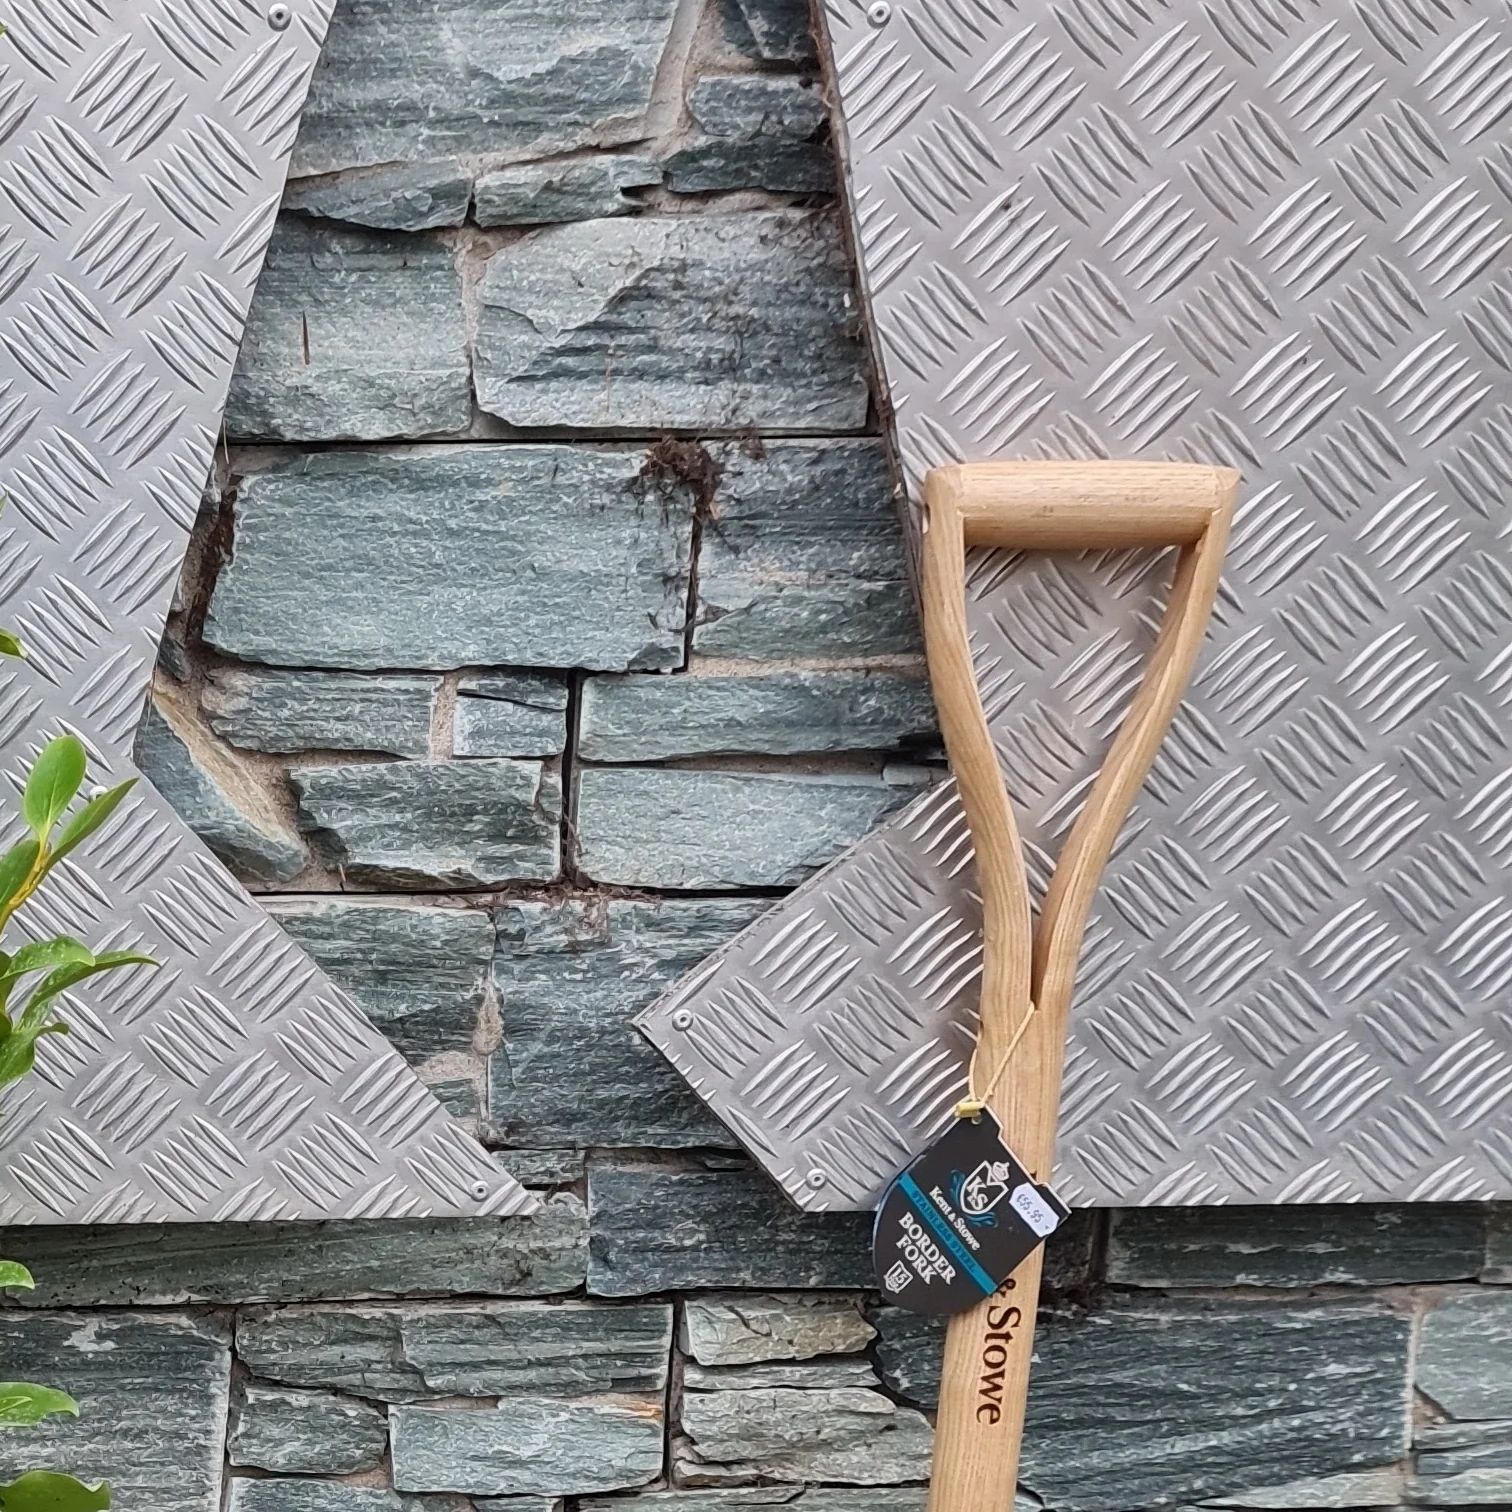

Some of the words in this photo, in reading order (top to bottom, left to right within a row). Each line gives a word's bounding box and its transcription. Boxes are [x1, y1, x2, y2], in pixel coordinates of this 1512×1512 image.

[898, 1211, 957, 1285] BORDER
[929, 1185, 953, 1216] Kent
[953, 1217, 981, 1251] Stowe
[891, 1267, 908, 1284] 15
[895, 1234, 937, 1285] FORK
[976, 1305, 1022, 1425] Stowe
